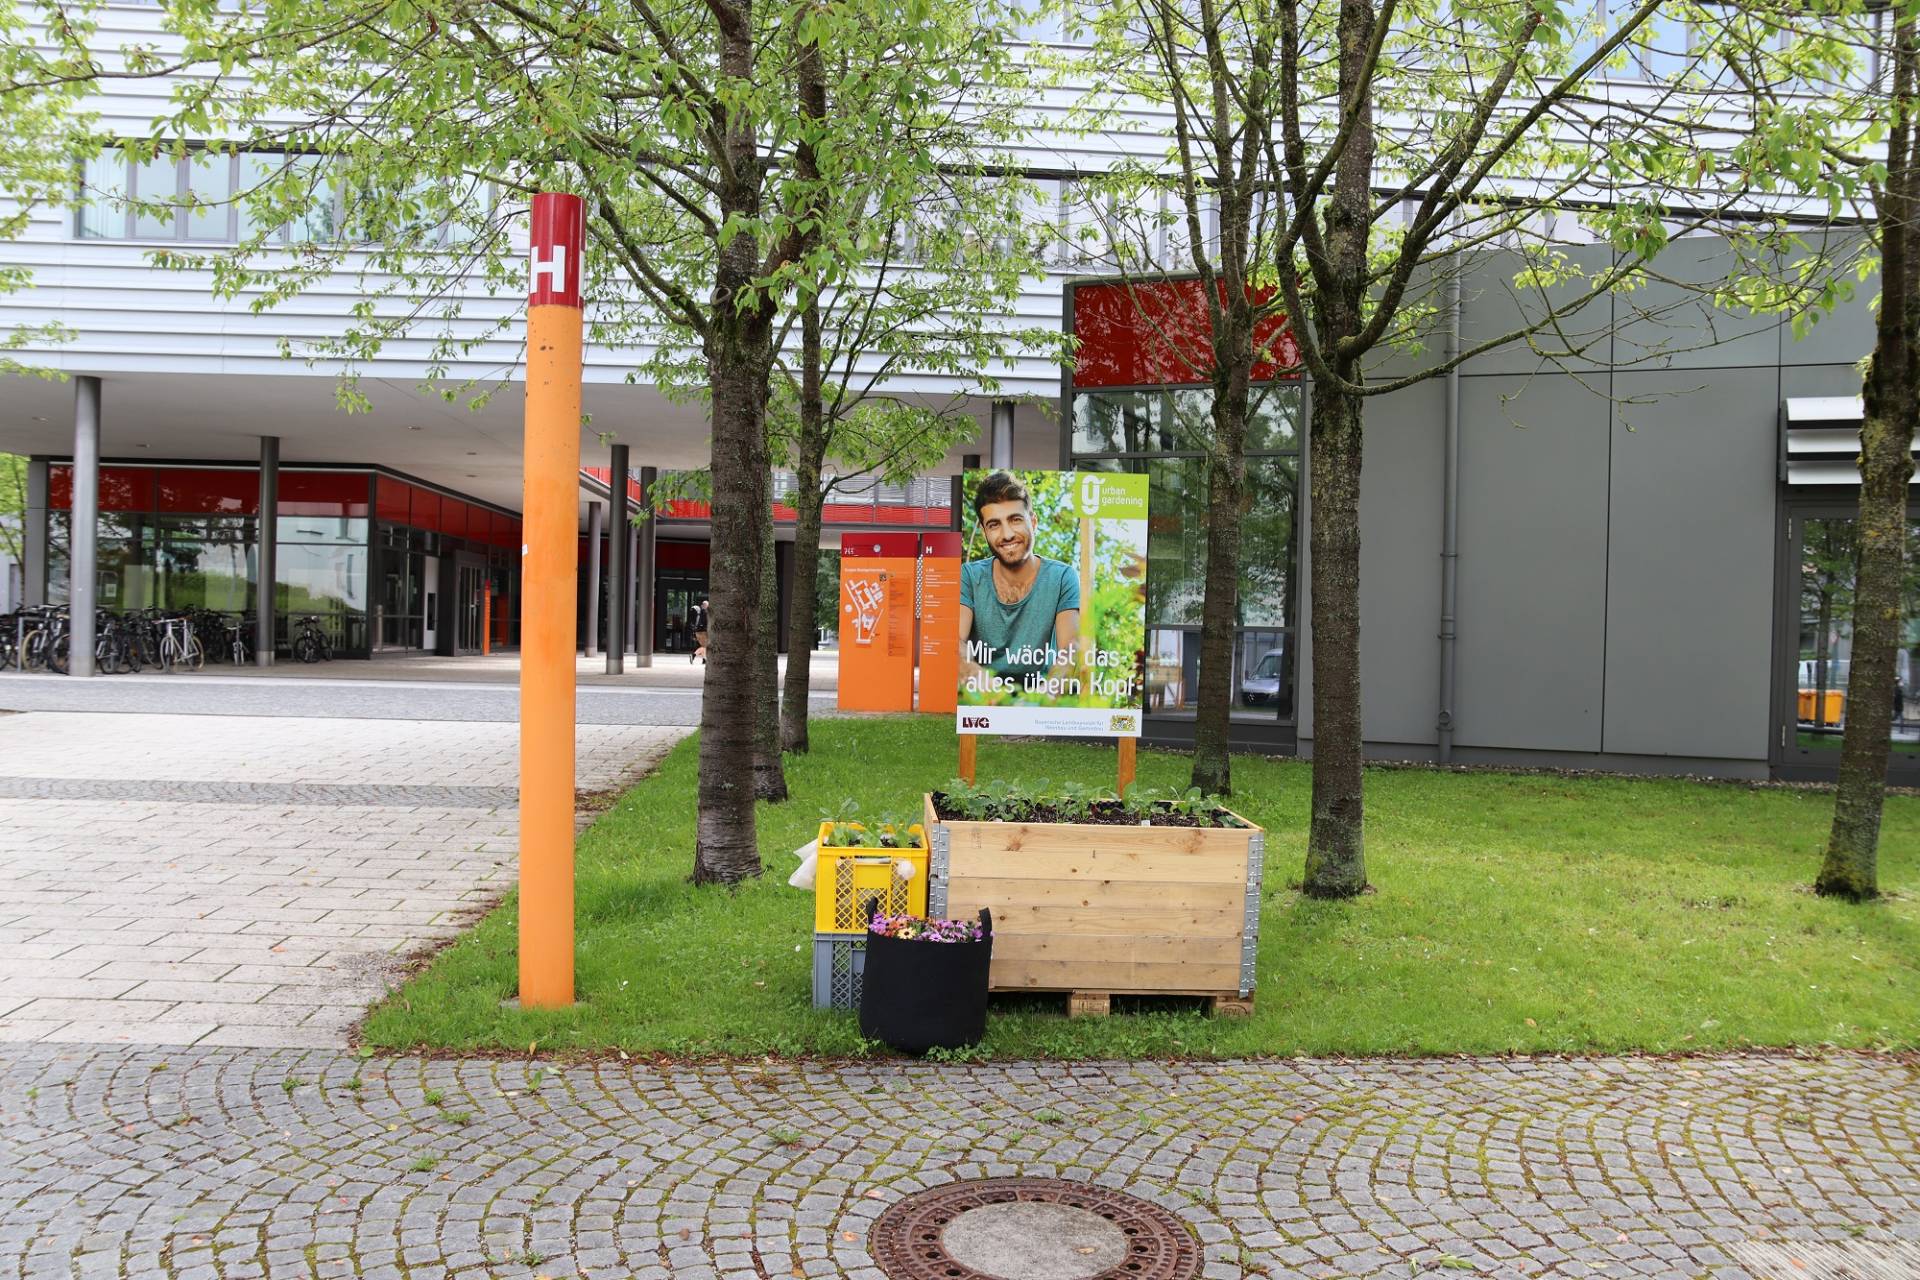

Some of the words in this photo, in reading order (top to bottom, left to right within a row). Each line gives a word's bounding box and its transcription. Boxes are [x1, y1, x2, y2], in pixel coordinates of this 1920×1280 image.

[530, 245, 566, 293] H
[1102, 486, 1126, 495] urban
[1101, 496, 1143, 508] gardening
[925, 546, 933, 554] H
[966, 640, 996, 664] Mir
[1005, 642, 1076, 666] wächst
[1084, 643, 1120, 667] das
[966, 670, 1015, 693] alles
[1023, 671, 1081, 695] übern
[1090, 672, 1136, 701] Kopf
[962, 717, 990, 728] LWG
